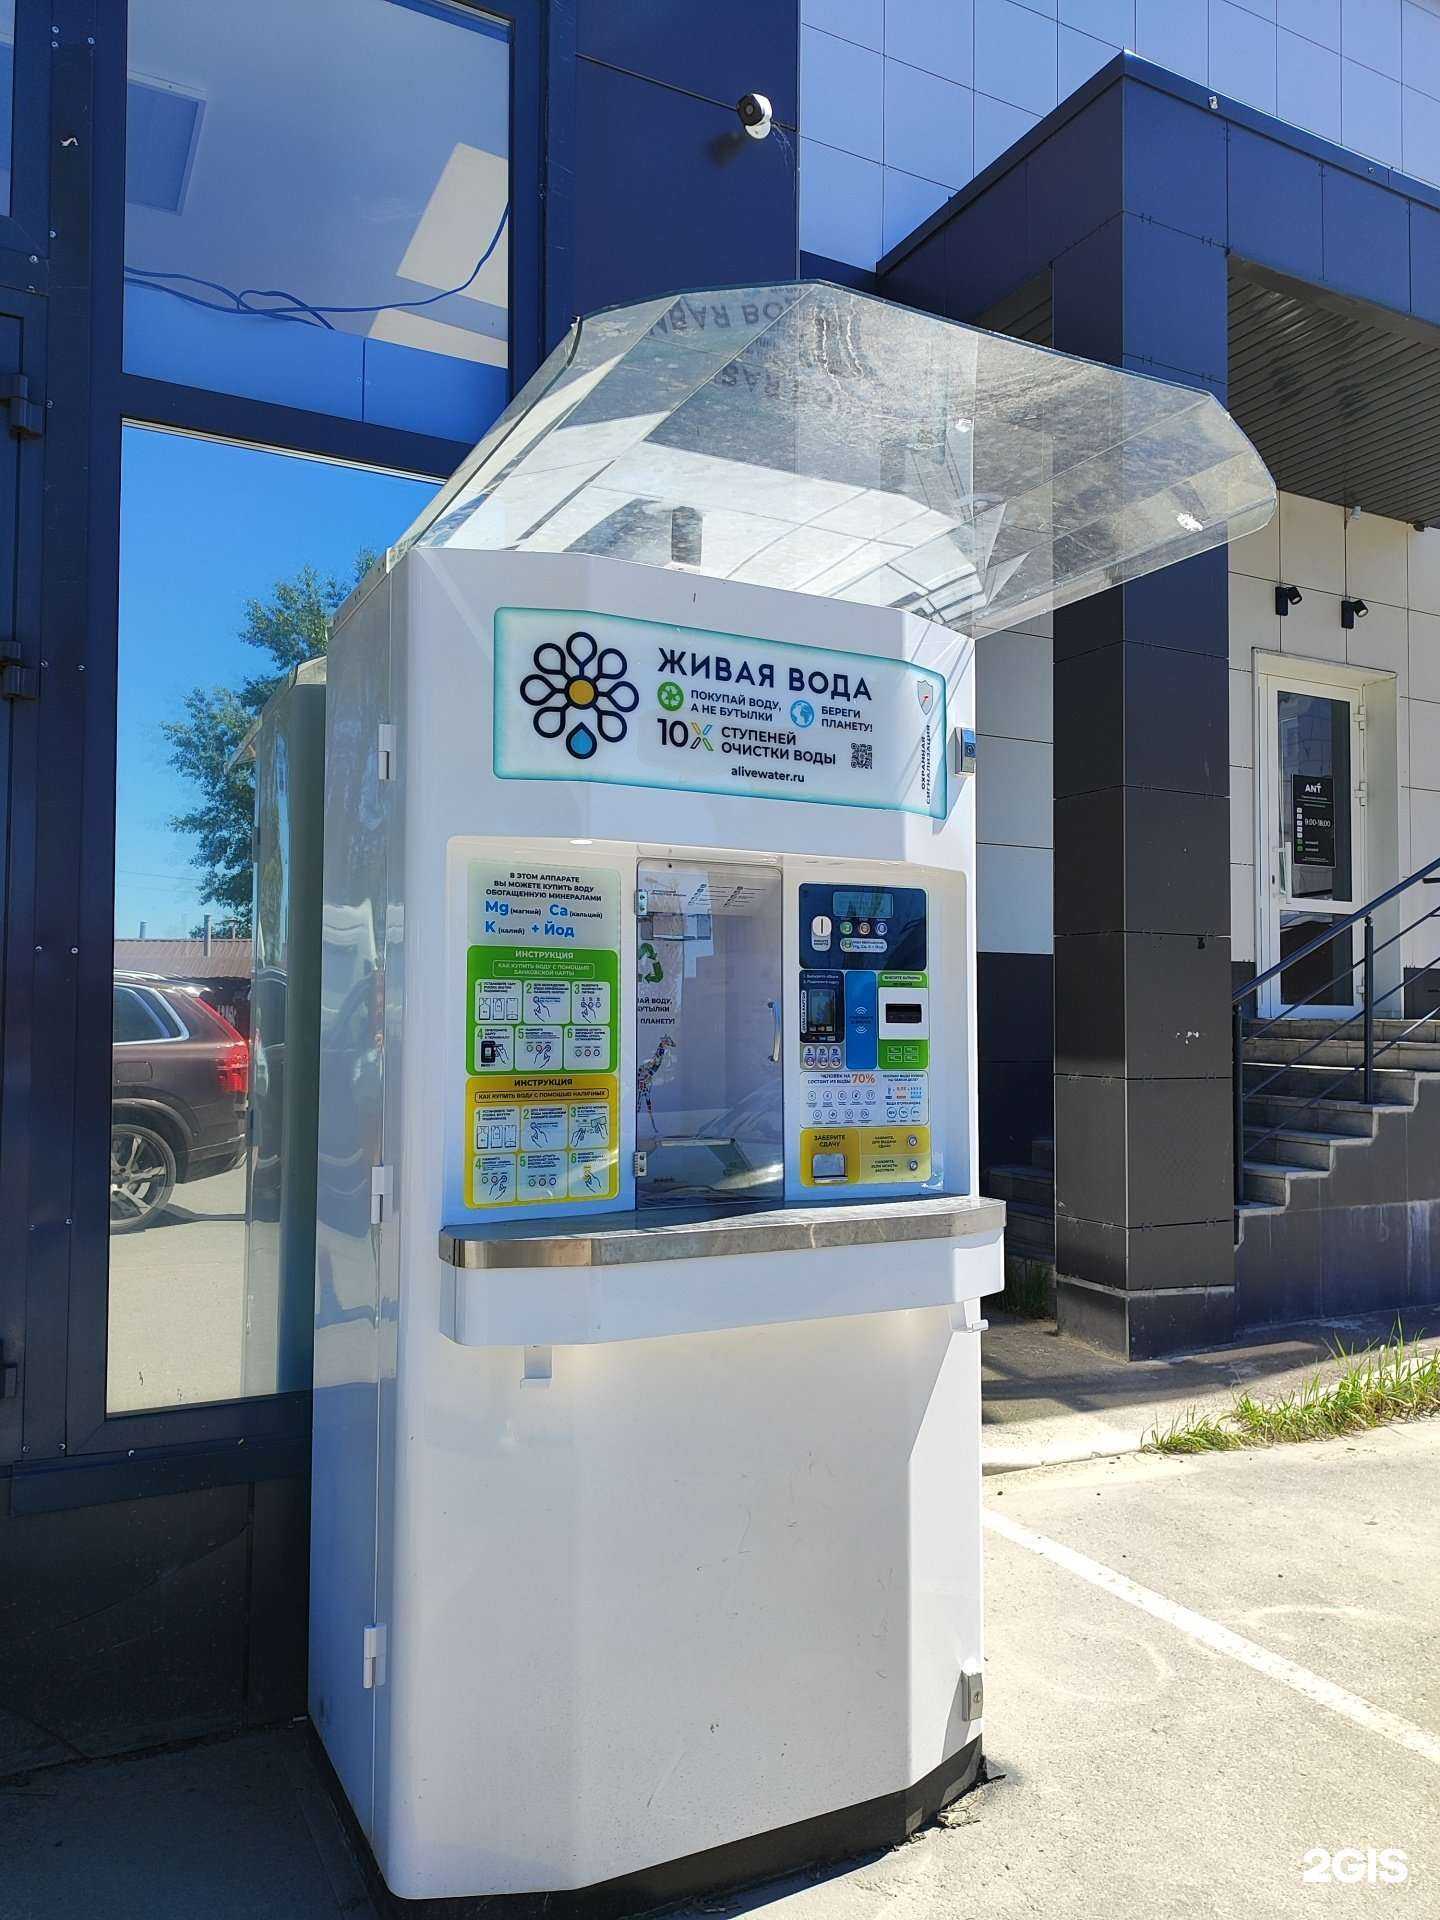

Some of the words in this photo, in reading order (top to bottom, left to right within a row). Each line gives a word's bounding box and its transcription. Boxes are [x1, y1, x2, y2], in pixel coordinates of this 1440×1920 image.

[657, 647, 775, 689] ЖИВАЯ
[788, 667, 873, 702] ВОДА
[690, 689, 747, 707] ПОКУПАЙ
[748, 697, 782, 713] ВОДУ,
[690, 703, 699, 712] А
[701, 704, 717, 716] НЕ
[719, 707, 773, 722] БУТЫЛКИ
[821, 705, 861, 719] БЕРЕГИ
[821, 718, 873, 733] ПЛАНЕТУ!
[721, 725, 797, 746] СТУПЕНЕЙ
[721, 741, 790, 761] ОЧИСТКИ
[793, 749, 836, 766] ВОДЫ
[731, 765, 805, 783] alivewater.ru
[516, 873, 538, 881] ЭТОМ
[540, 874, 580, 883] АППАРАТЕ
[508, 881, 542, 890] МОЖЕТЕ
[542, 884, 572, 892] КУПИТЬ
[574, 885, 594, 893] ВОДУ
[486, 888, 547, 899] ОБОГАЩЕННУЮ
[548, 892, 602, 902] МИНЕРАЛАМИ
[485, 900, 509, 916] Mg
[510, 908, 542, 916] (магний)
[549, 904, 568, 916] Ca
[569, 910, 603, 920] (кальций)
[498, 927, 525, 936] (калий)
[544, 920, 575, 938] Йод
[514, 950, 574, 960] ИНСТРУКЦИЯ
[514, 1078, 573, 1086] ИНСТРУКЦИЯ
[852, 1074, 876, 1084] 70%
